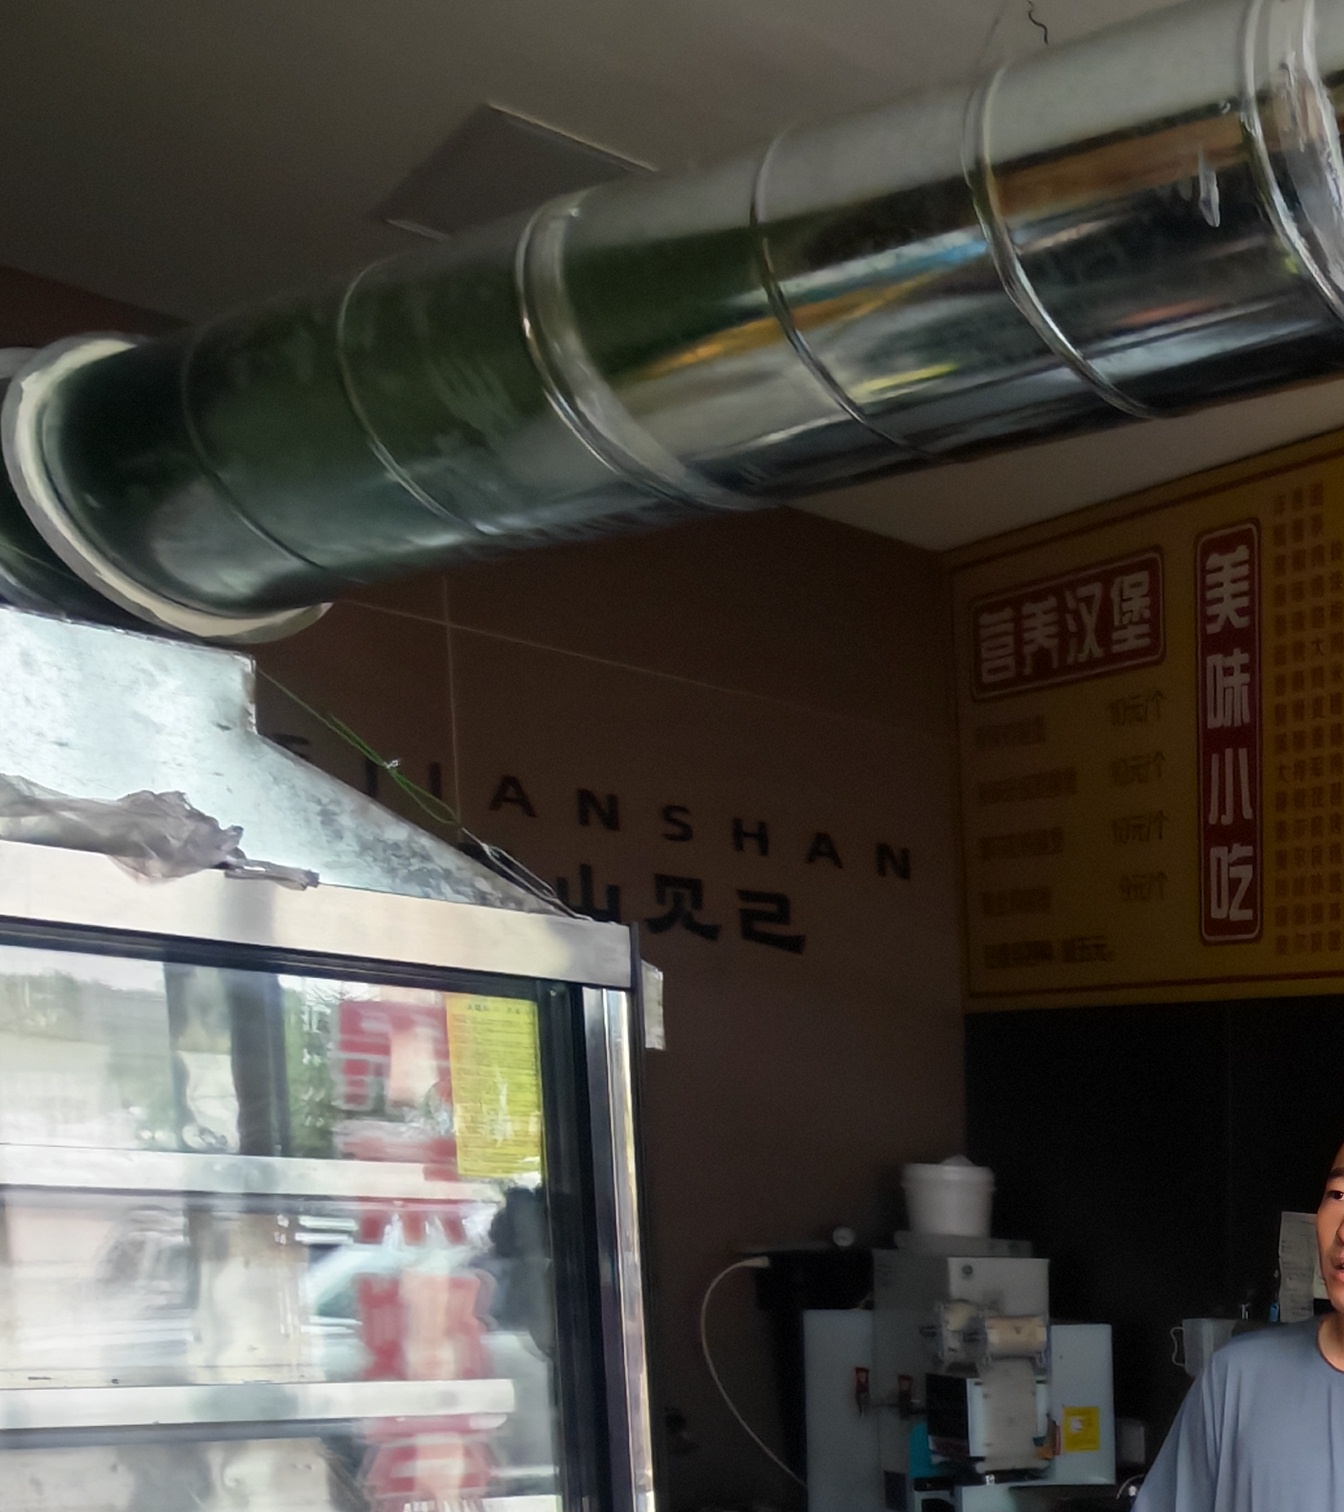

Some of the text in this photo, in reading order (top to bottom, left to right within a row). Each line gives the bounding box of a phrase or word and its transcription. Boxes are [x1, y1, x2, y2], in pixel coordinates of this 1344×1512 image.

[977, 570, 1151, 684] 营养汉堡
[1204, 544, 1254, 921] 美味小吃
